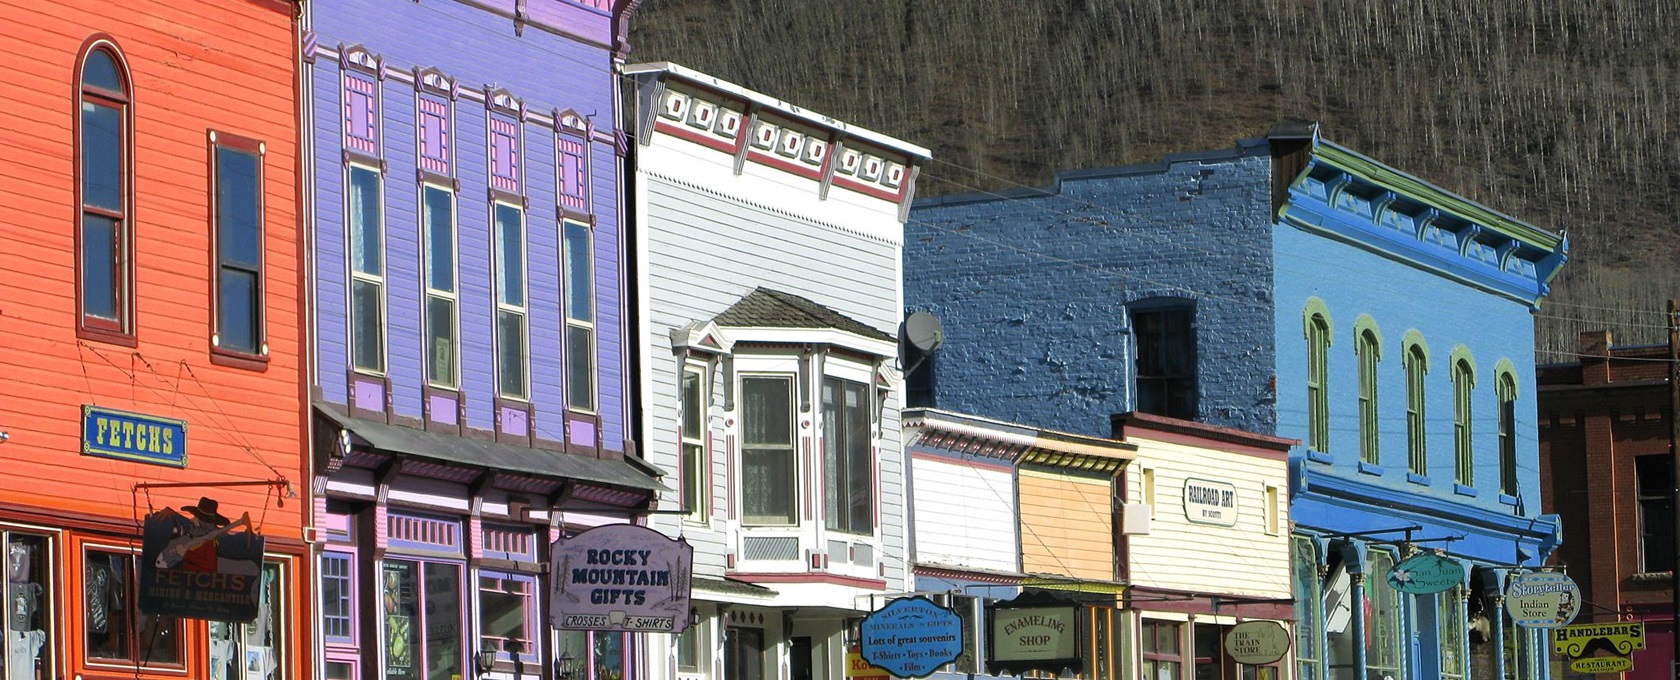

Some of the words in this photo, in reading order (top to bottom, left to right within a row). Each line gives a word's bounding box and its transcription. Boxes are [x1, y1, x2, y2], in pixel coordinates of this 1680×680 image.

[97, 417, 173, 454] FETCHS
[1188, 485, 1220, 506] RAILROAD
[1221, 490, 1233, 508] ART
[586, 549, 652, 566] ROCKY
[155, 568, 246, 591] FETCHS
[572, 568, 669, 587] MOUNTAIN
[1414, 578, 1456, 589] Sweets
[1512, 582, 1575, 598] Storyteller
[195, 590, 251, 605] MERCANTILE
[590, 588, 646, 606] GIFTS
[1520, 600, 1549, 608] Indian
[882, 606, 938, 619] SILVERTON
[1522, 609, 1547, 617] Store
[565, 615, 607, 627] CROSSES
[870, 622, 914, 631] MINERALS
[927, 620, 953, 630] GIFTS
[1003, 615, 1066, 636] ENAMELING
[868, 636, 886, 646] Lots
[887, 634, 897, 645] of
[897, 636, 917, 647] great
[919, 632, 956, 643] souvenirs
[1555, 625, 1640, 641] HANDLEBARS
[1019, 635, 1051, 646] SHOP
[1234, 639, 1260, 647] TRAIN
[906, 650, 924, 659] Toys
[929, 648, 953, 658] Books
[1234, 646, 1260, 654] STORE
[904, 663, 921, 671] Film
[1575, 660, 1626, 669] RESTAURANT
